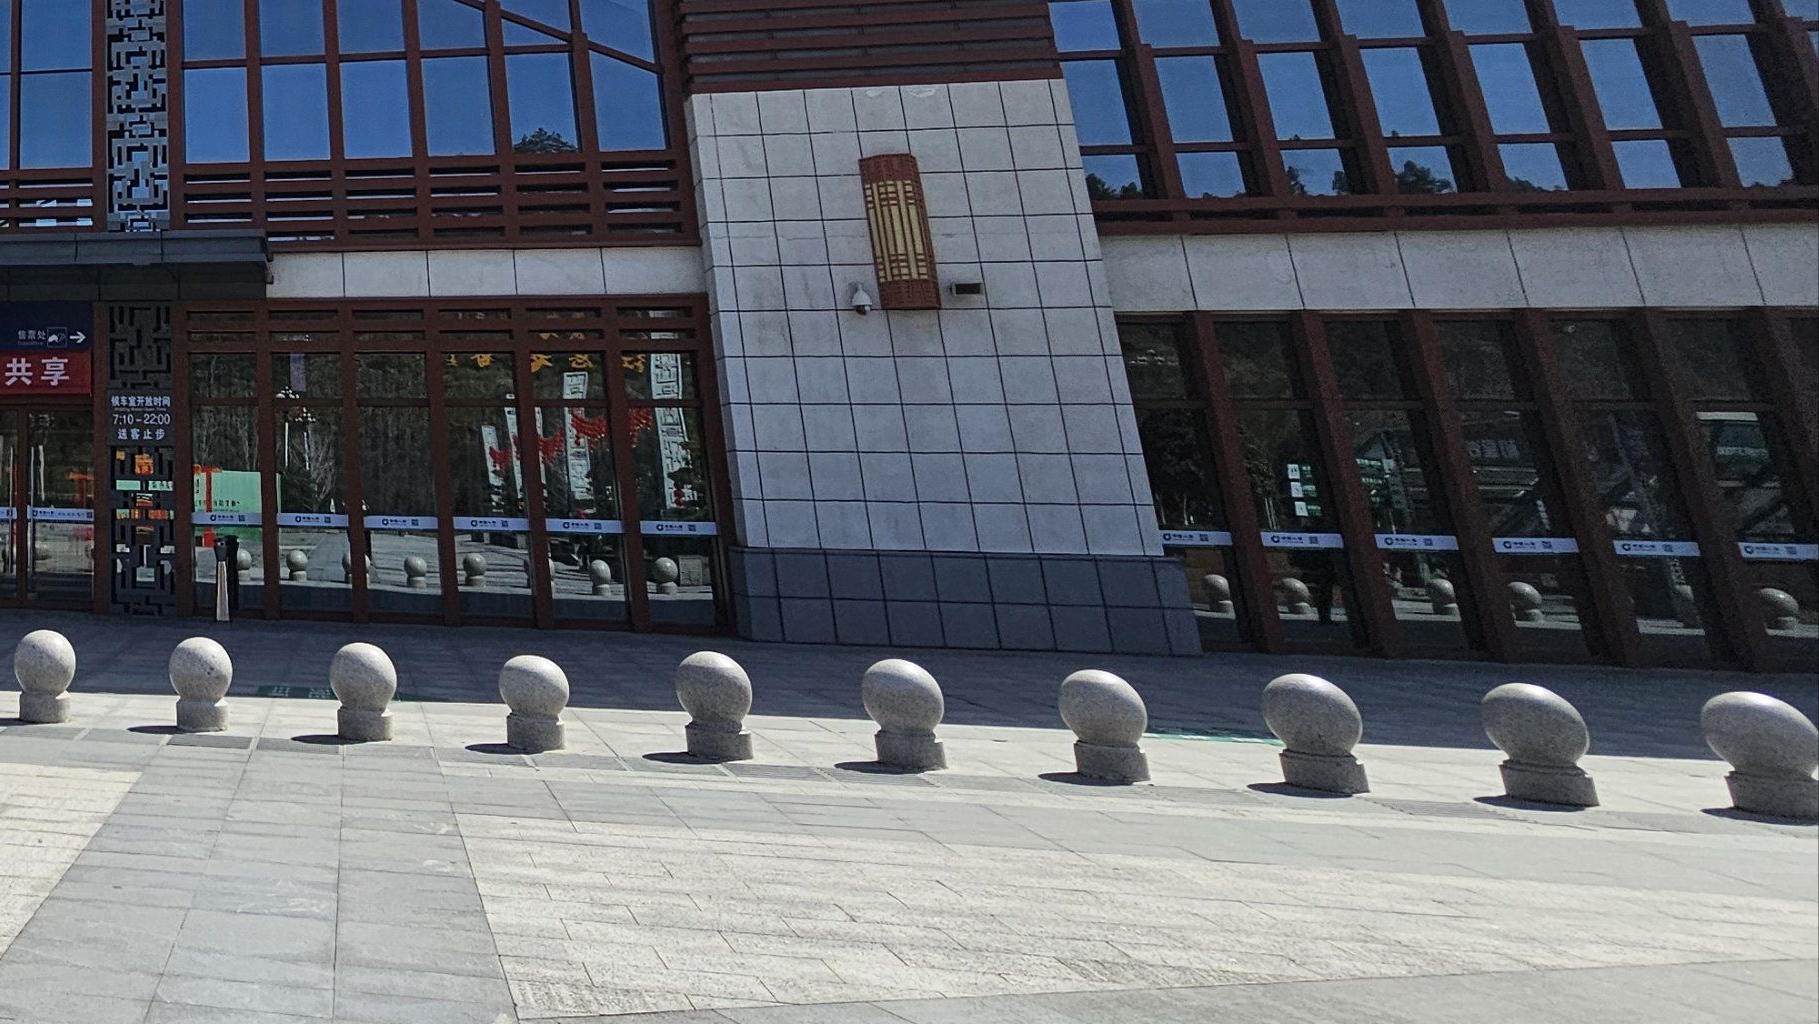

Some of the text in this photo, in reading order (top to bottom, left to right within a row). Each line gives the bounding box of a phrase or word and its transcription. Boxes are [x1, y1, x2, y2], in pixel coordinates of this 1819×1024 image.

[111, 395, 171, 407] 候车室开放时间
[117, 428, 166, 441] 送客止步
